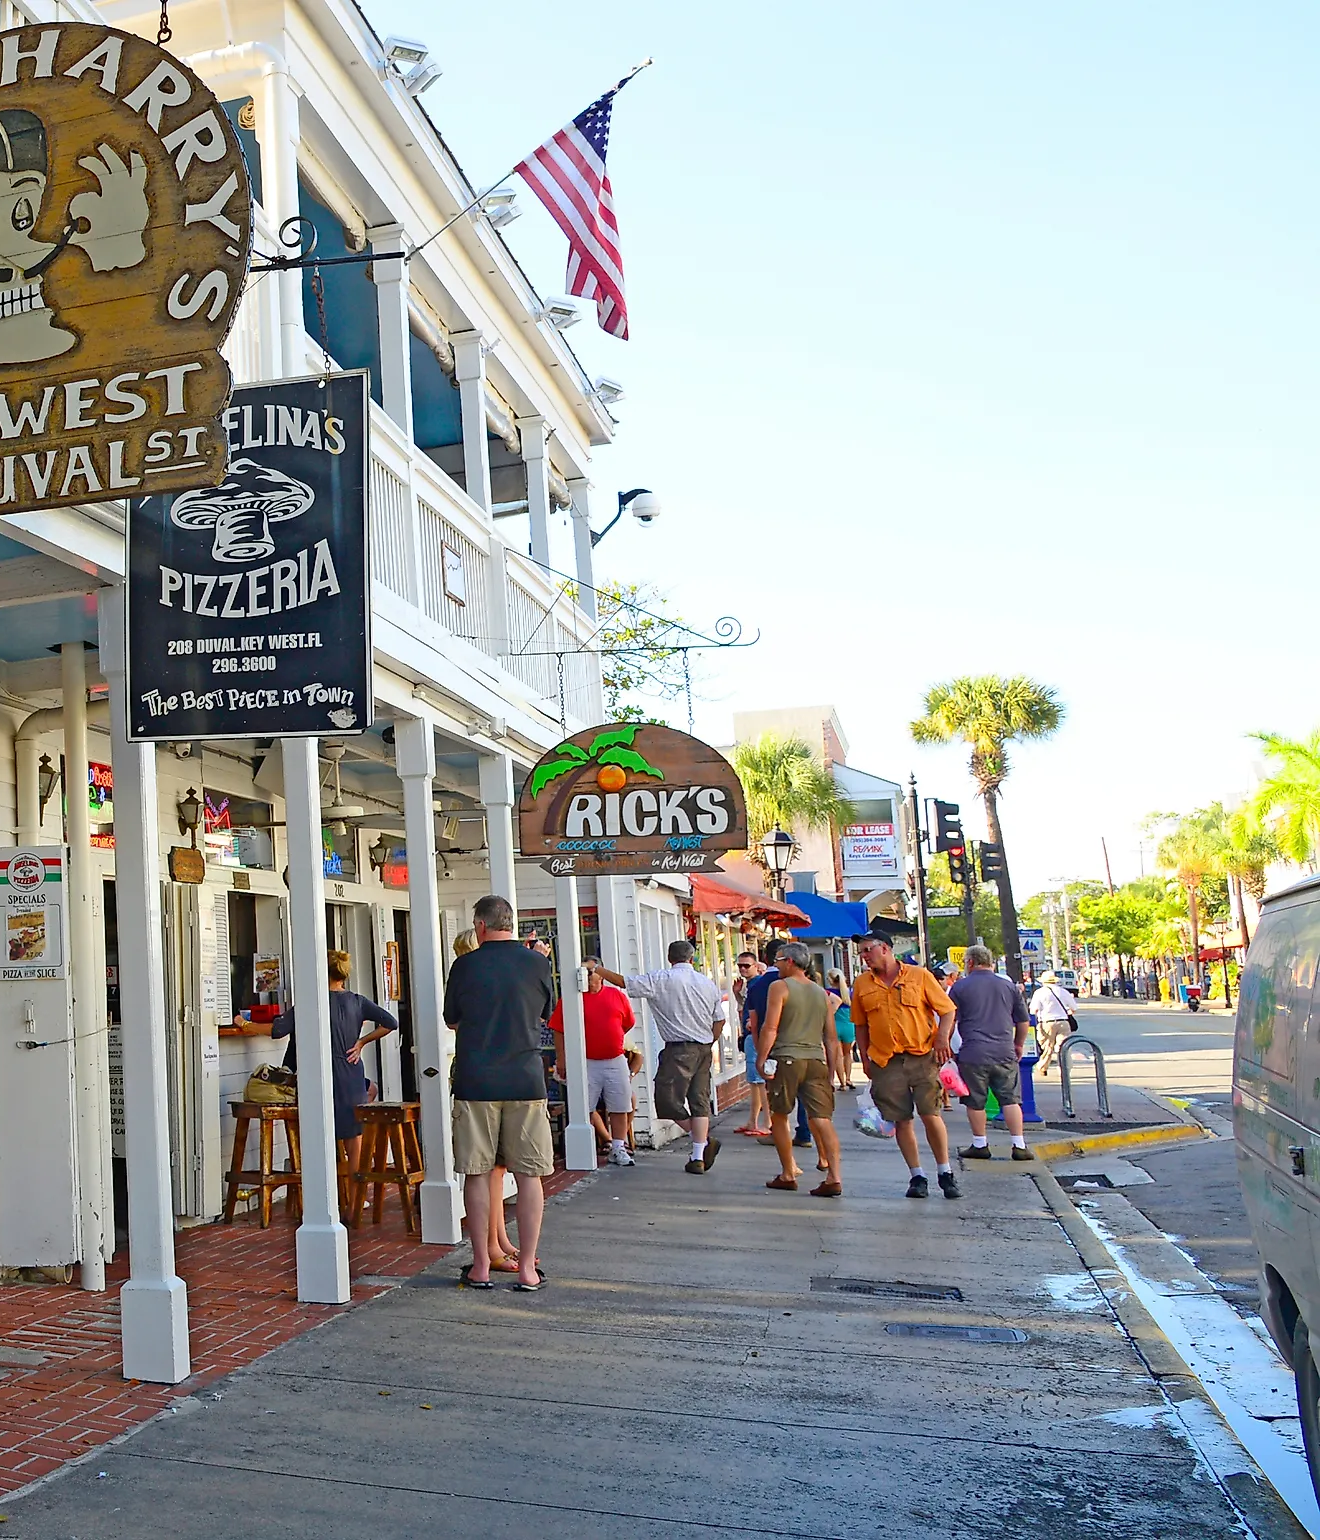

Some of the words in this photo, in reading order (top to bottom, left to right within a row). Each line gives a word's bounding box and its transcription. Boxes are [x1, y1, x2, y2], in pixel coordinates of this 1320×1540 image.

[0, 30, 243, 324] HARRY'S
[223, 404, 346, 455] ELINA'S
[159, 538, 341, 619] PIZZERIA
[168, 639, 193, 655] 208
[212, 655, 277, 673] 296.3600
[566, 786, 728, 838] RICK'S
[865, 825, 890, 835] LEASE
[852, 845, 883, 854] RE/MAX
[551, 858, 576, 874] Best
[661, 855, 680, 870] Key
[7, 894, 46, 904] SPECIALS
[333, 883, 345, 898] 202
[3, 970, 23, 979] PIZZA
[37, 969, 57, 978] SLICE
